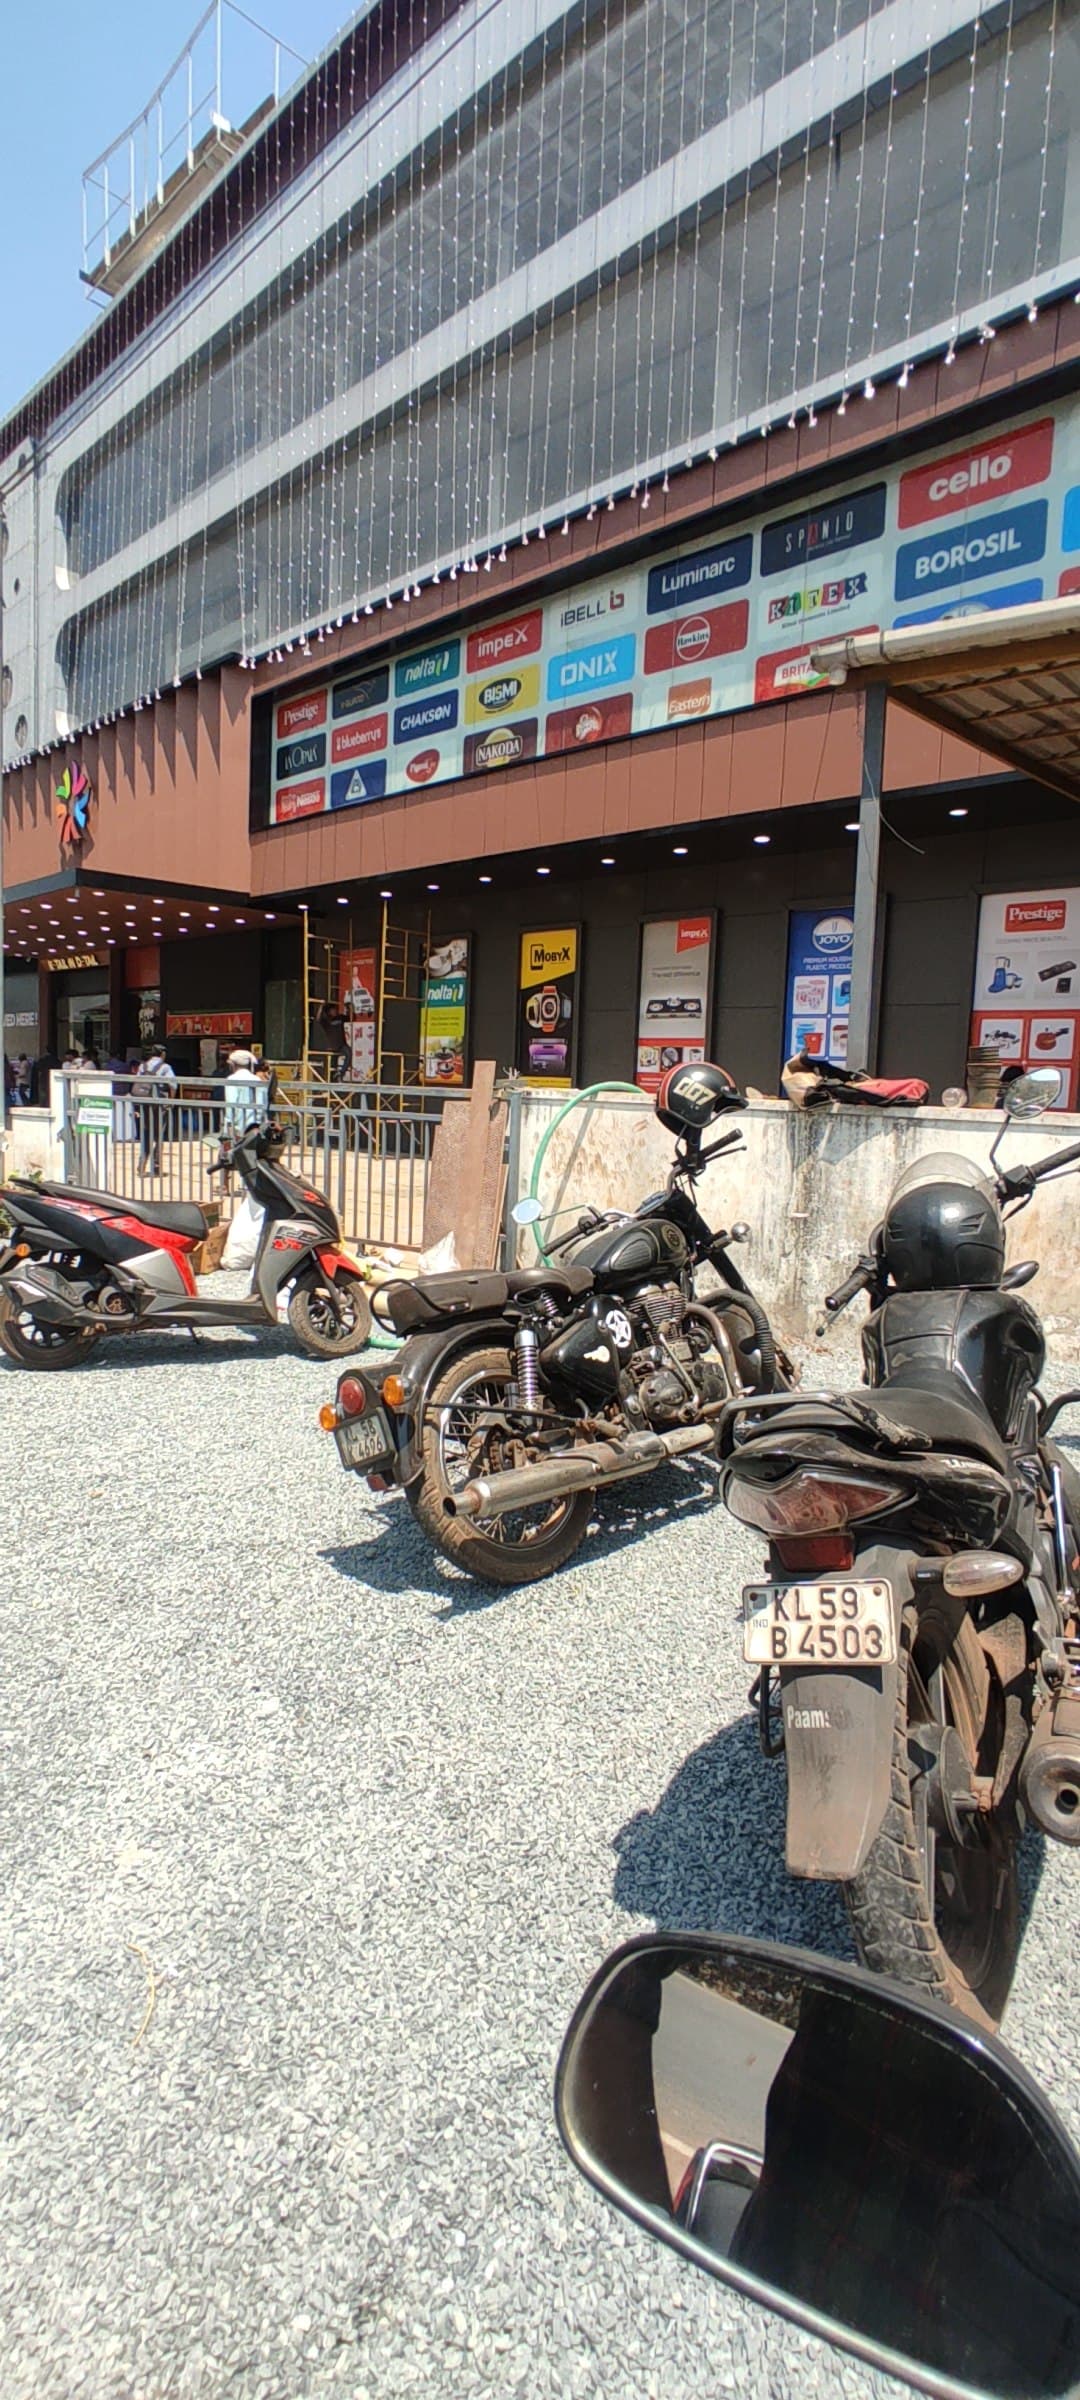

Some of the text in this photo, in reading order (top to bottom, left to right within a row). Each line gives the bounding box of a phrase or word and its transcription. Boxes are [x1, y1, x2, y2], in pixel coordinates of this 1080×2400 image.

[929, 454, 1012, 501] cello
[785, 511, 854, 553] SPANIO
[915, 528, 1022, 580] BOROSIL
[661, 557, 736, 595] Luminarc
[768, 574, 866, 623] KITEX
[677, 631, 710, 648] Hawkins
[560, 650, 618, 688] ONIX
[782, 662, 814, 680] BRITA
[483, 680, 518, 705] BISMI
[668, 692, 711, 715] Eastern
[283, 704, 319, 726] Prestige
[400, 703, 452, 732] CHAKSON
[341, 727, 382, 749] blueberrys
[477, 738, 520, 763] NAKODA
[1009, 905, 1064, 922] Prestige
[819, 934, 851, 945] JOYO
[673, 1076, 717, 1106] 007
[773, 1587, 858, 1622] KL 59
[771, 1624, 884, 1660] B 4503
